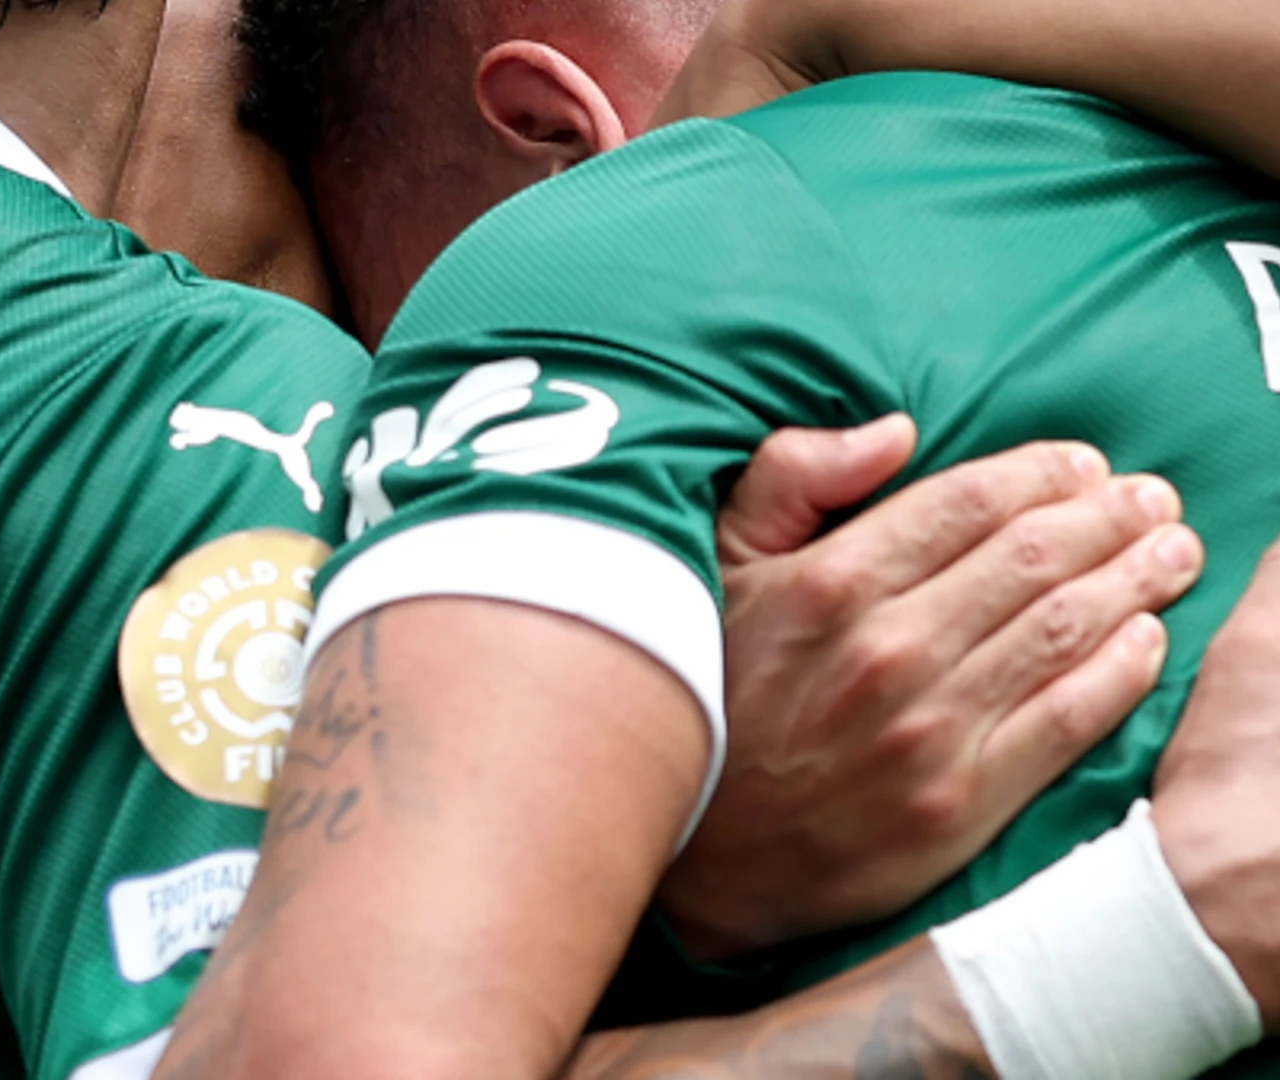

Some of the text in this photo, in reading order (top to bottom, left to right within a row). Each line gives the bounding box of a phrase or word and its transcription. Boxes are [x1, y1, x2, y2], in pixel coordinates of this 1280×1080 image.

[153, 559, 280, 747] CLUB WORLD
[223, 742, 287, 784] FI
[147, 863, 249, 918] FOOTBAL
